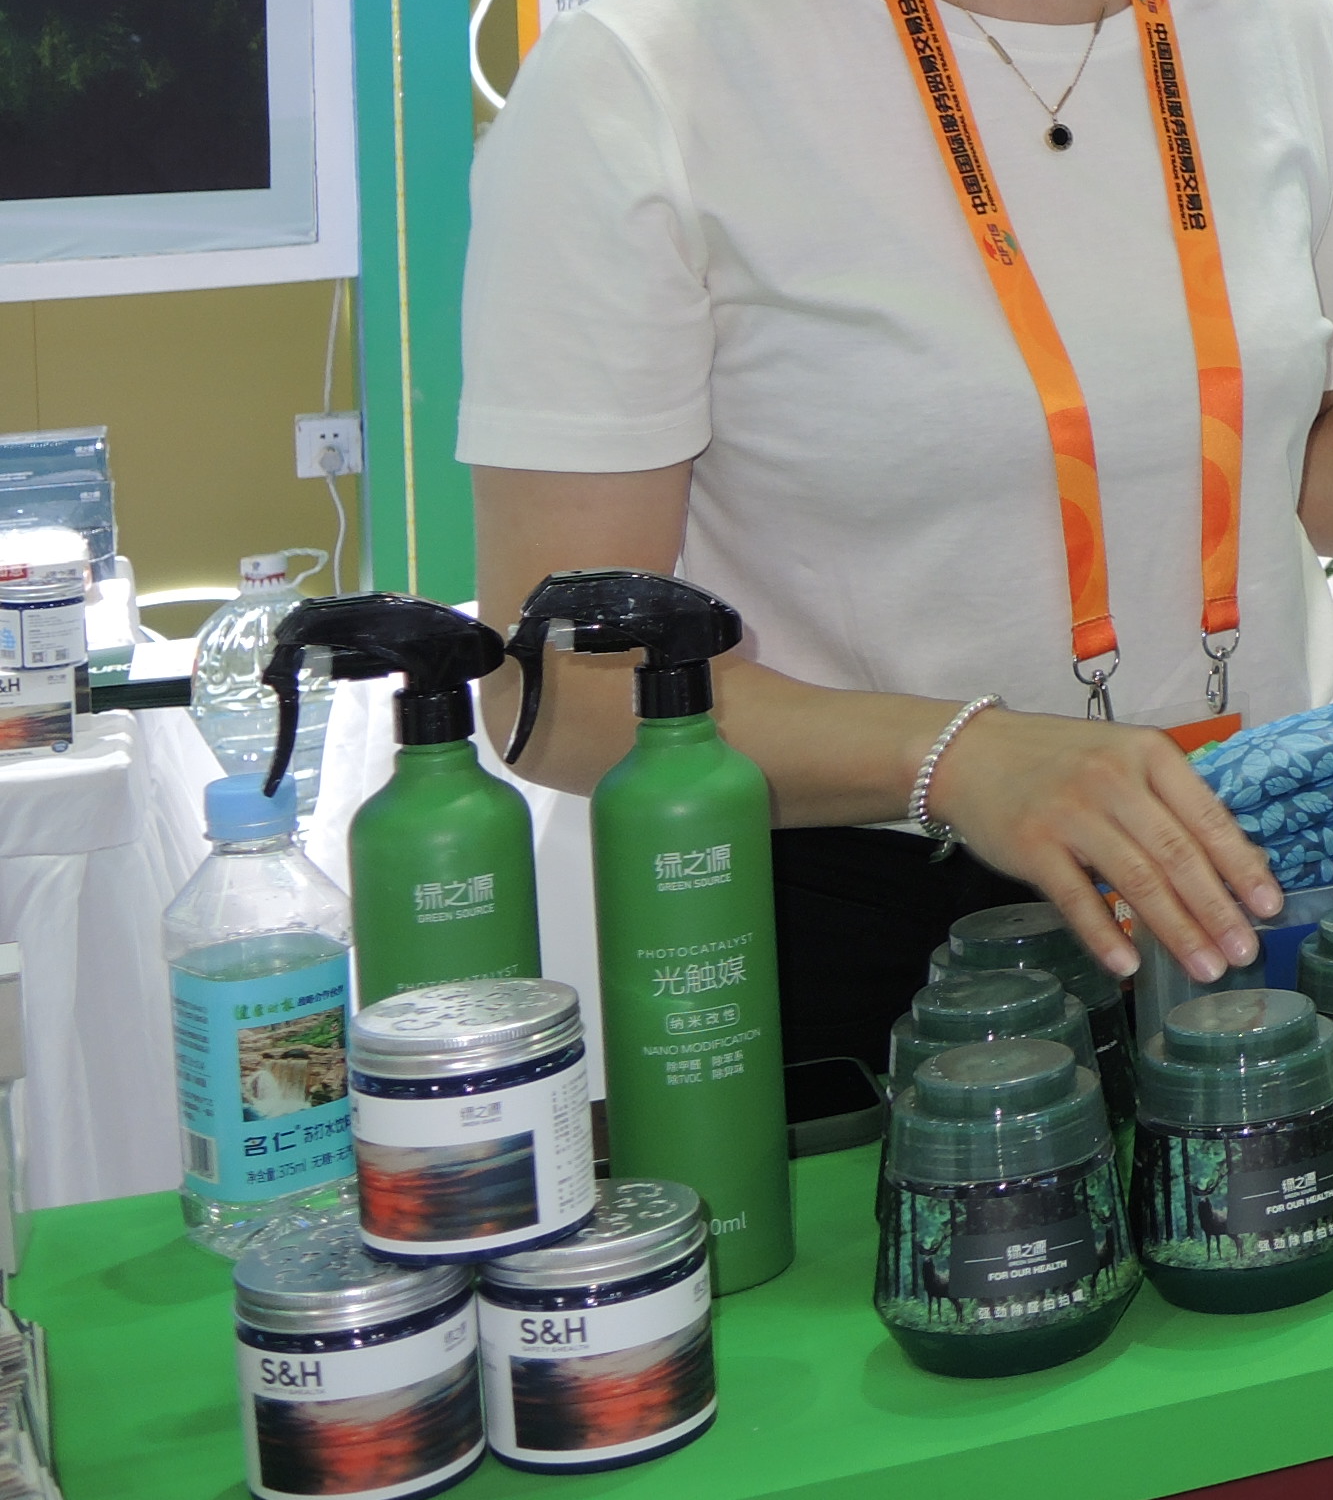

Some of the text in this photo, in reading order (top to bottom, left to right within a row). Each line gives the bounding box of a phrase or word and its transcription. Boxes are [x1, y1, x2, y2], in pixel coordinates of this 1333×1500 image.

[1153, 22, 1207, 231] 中国国际服务贸易交易会
[986, 222, 1013, 267] CIFTIS
[654, 843, 732, 880] 绿之源
[415, 873, 495, 911] 绿之源
[657, 873, 732, 893] GREEN SOURCE
[417, 903, 495, 924] GREEN SOURCE
[637, 932, 754, 960] PHOTOCATALYST
[652, 954, 747, 997] 光触媒
[669, 1007, 737, 1030] 纳米改性
[643, 1028, 761, 1057] NANO MODIFICATION
[243, 1130, 296, 1157] 名仁
[1282, 1170, 1317, 1194] 绿之源
[1265, 1188, 1333, 1216] FOR OUR HEALTH
[1006, 1239, 1048, 1261] 绿之源
[987, 1259, 1068, 1281] FOR OUR HEALTH
[520, 1316, 588, 1345] S&H
[261, 1358, 323, 1388] S&H
